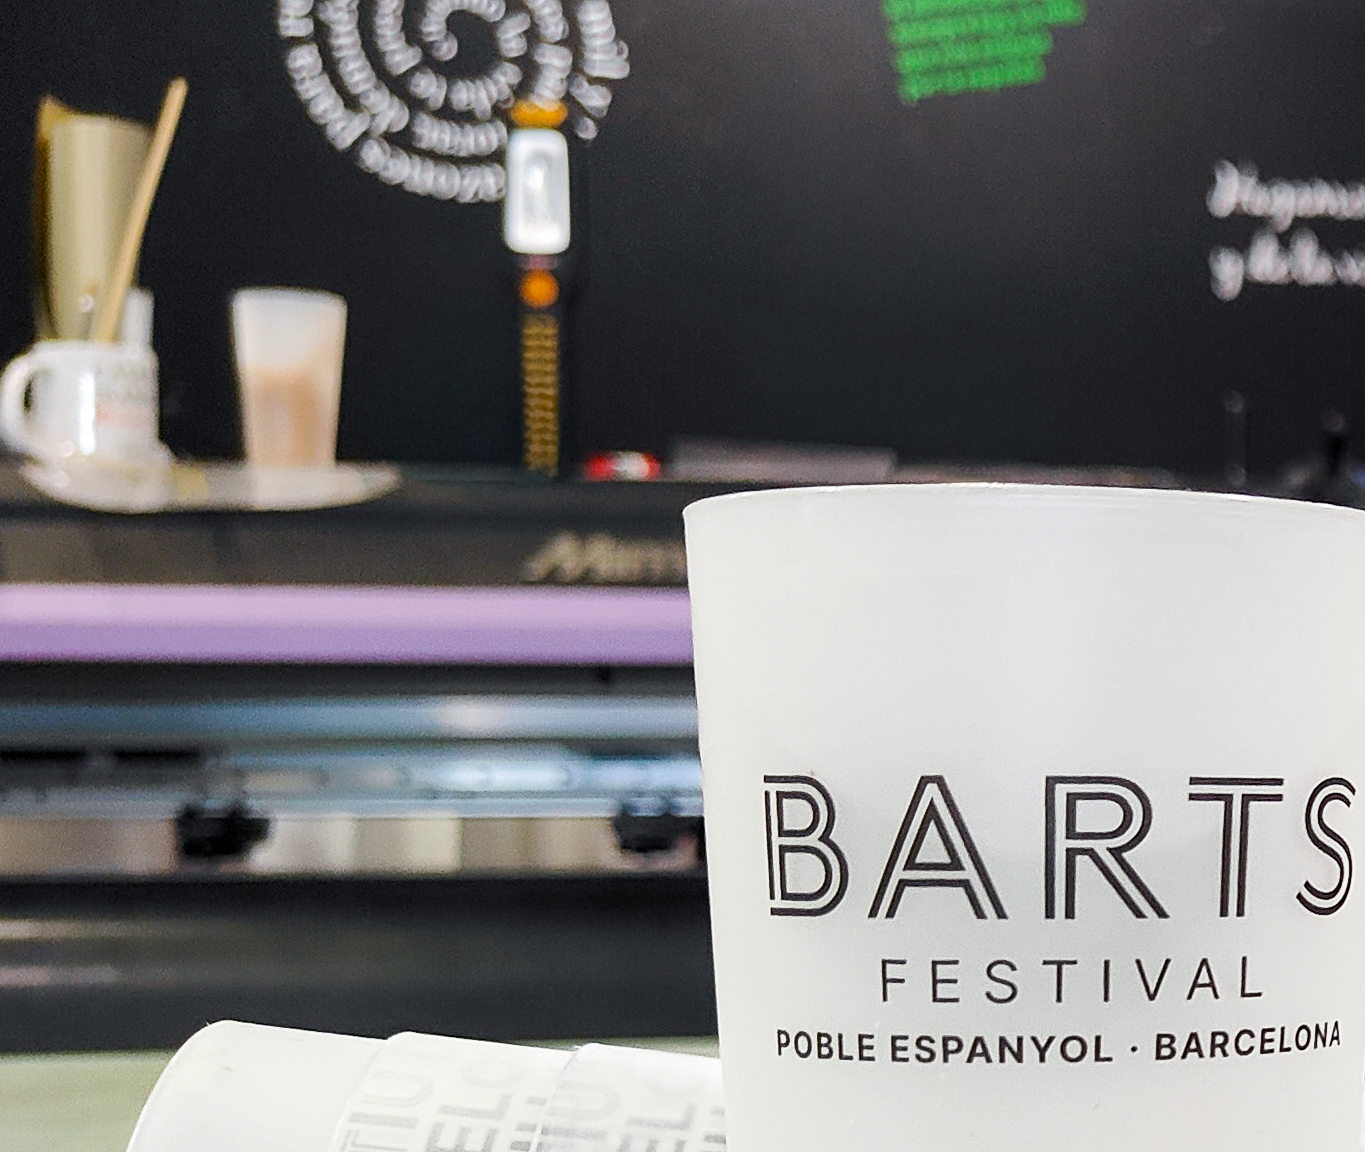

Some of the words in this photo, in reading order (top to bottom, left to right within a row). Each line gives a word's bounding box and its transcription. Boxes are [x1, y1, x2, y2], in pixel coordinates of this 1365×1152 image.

[763, 774, 1356, 920] BARTS
[881, 956, 1265, 1005] FESTIVAL
[776, 1029, 875, 1062] POBLE
[891, 1034, 1113, 1064] ESPANYOL
[1155, 1020, 1341, 1061] BARCELONA
